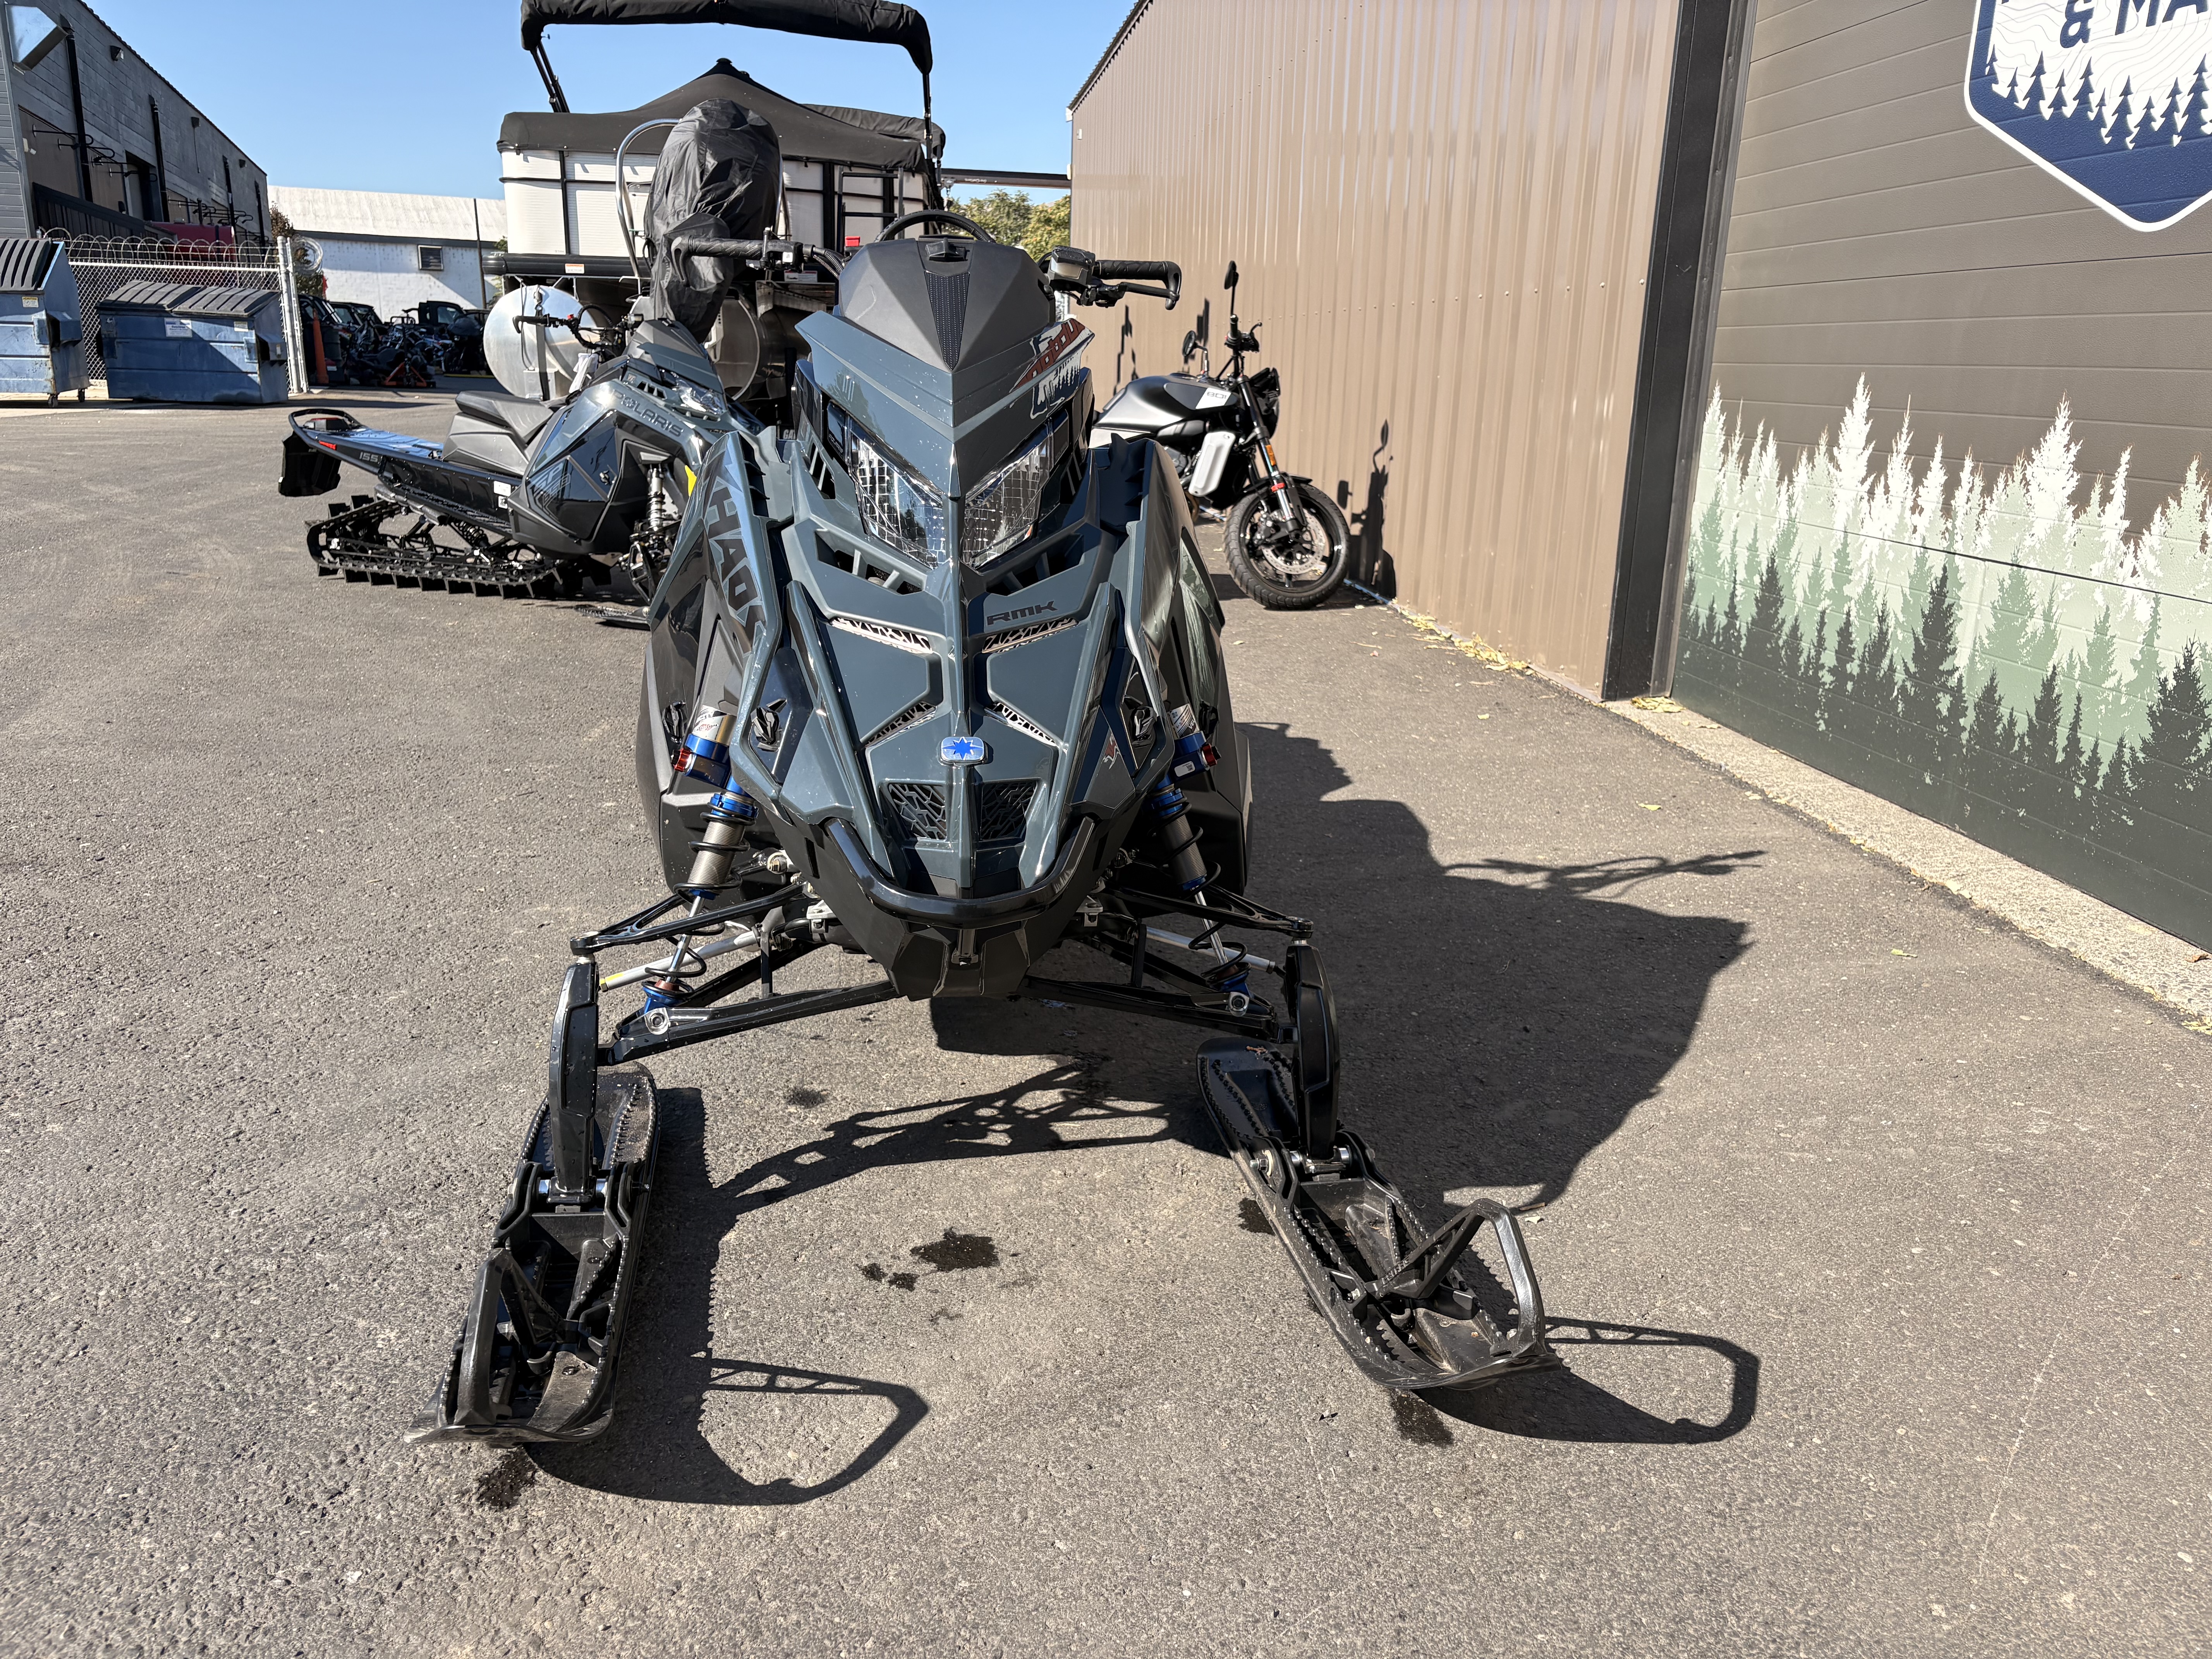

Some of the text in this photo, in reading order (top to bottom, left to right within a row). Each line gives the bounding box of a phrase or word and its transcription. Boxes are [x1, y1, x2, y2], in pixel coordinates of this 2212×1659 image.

[612, 388, 685, 438] POLARIS
[359, 452, 379, 462] 155
[987, 601, 1058, 626] RMK
